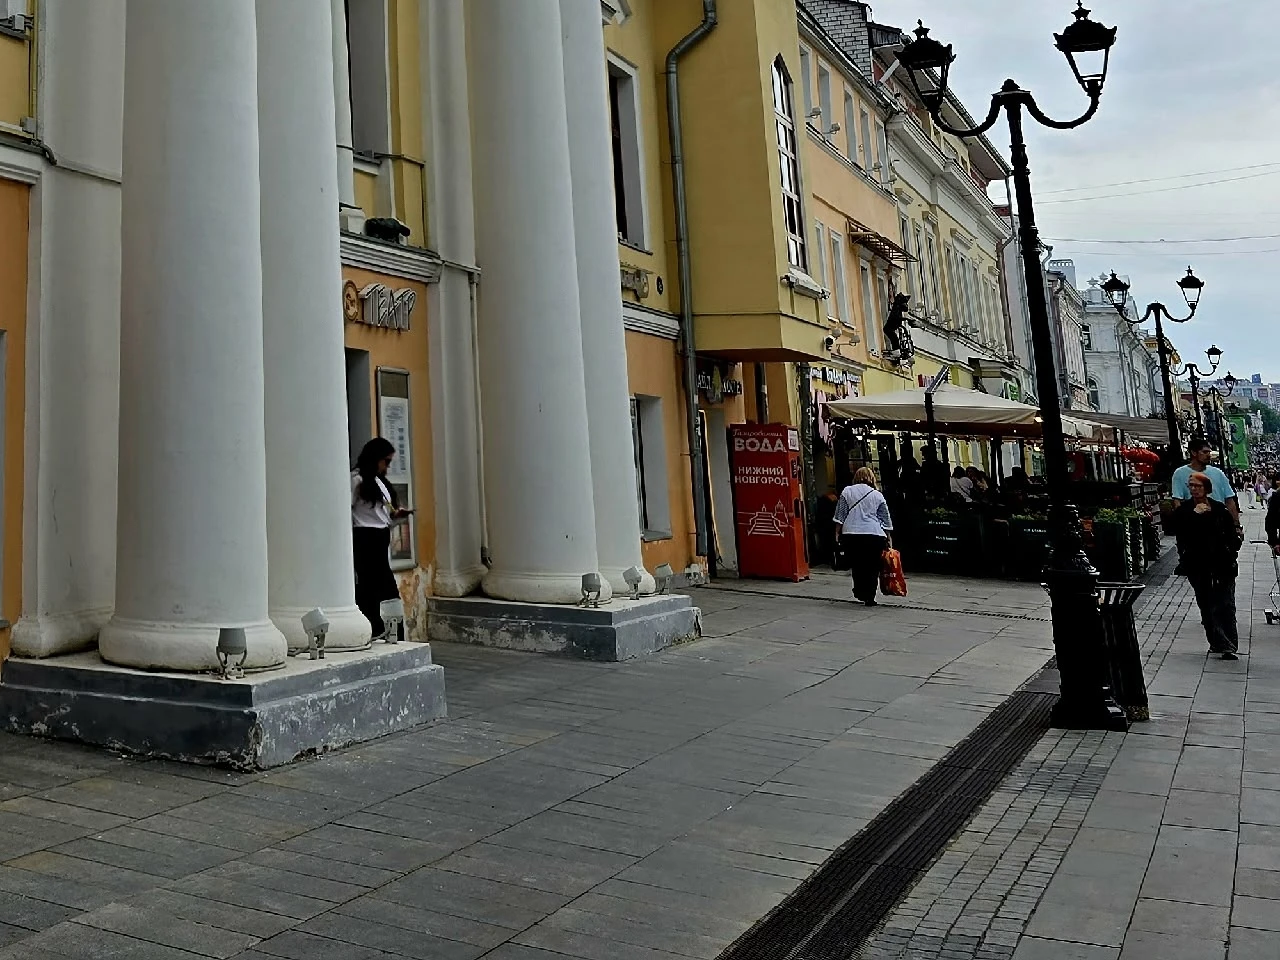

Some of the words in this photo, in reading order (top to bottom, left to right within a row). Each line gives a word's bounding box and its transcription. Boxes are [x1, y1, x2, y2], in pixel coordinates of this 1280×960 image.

[361, 283, 416, 331] ТЕАТР
[734, 437, 787, 452] ВОДА
[738, 466, 784, 476] НИЖНИЙ
[734, 475, 789, 487] НОВГОРОД
